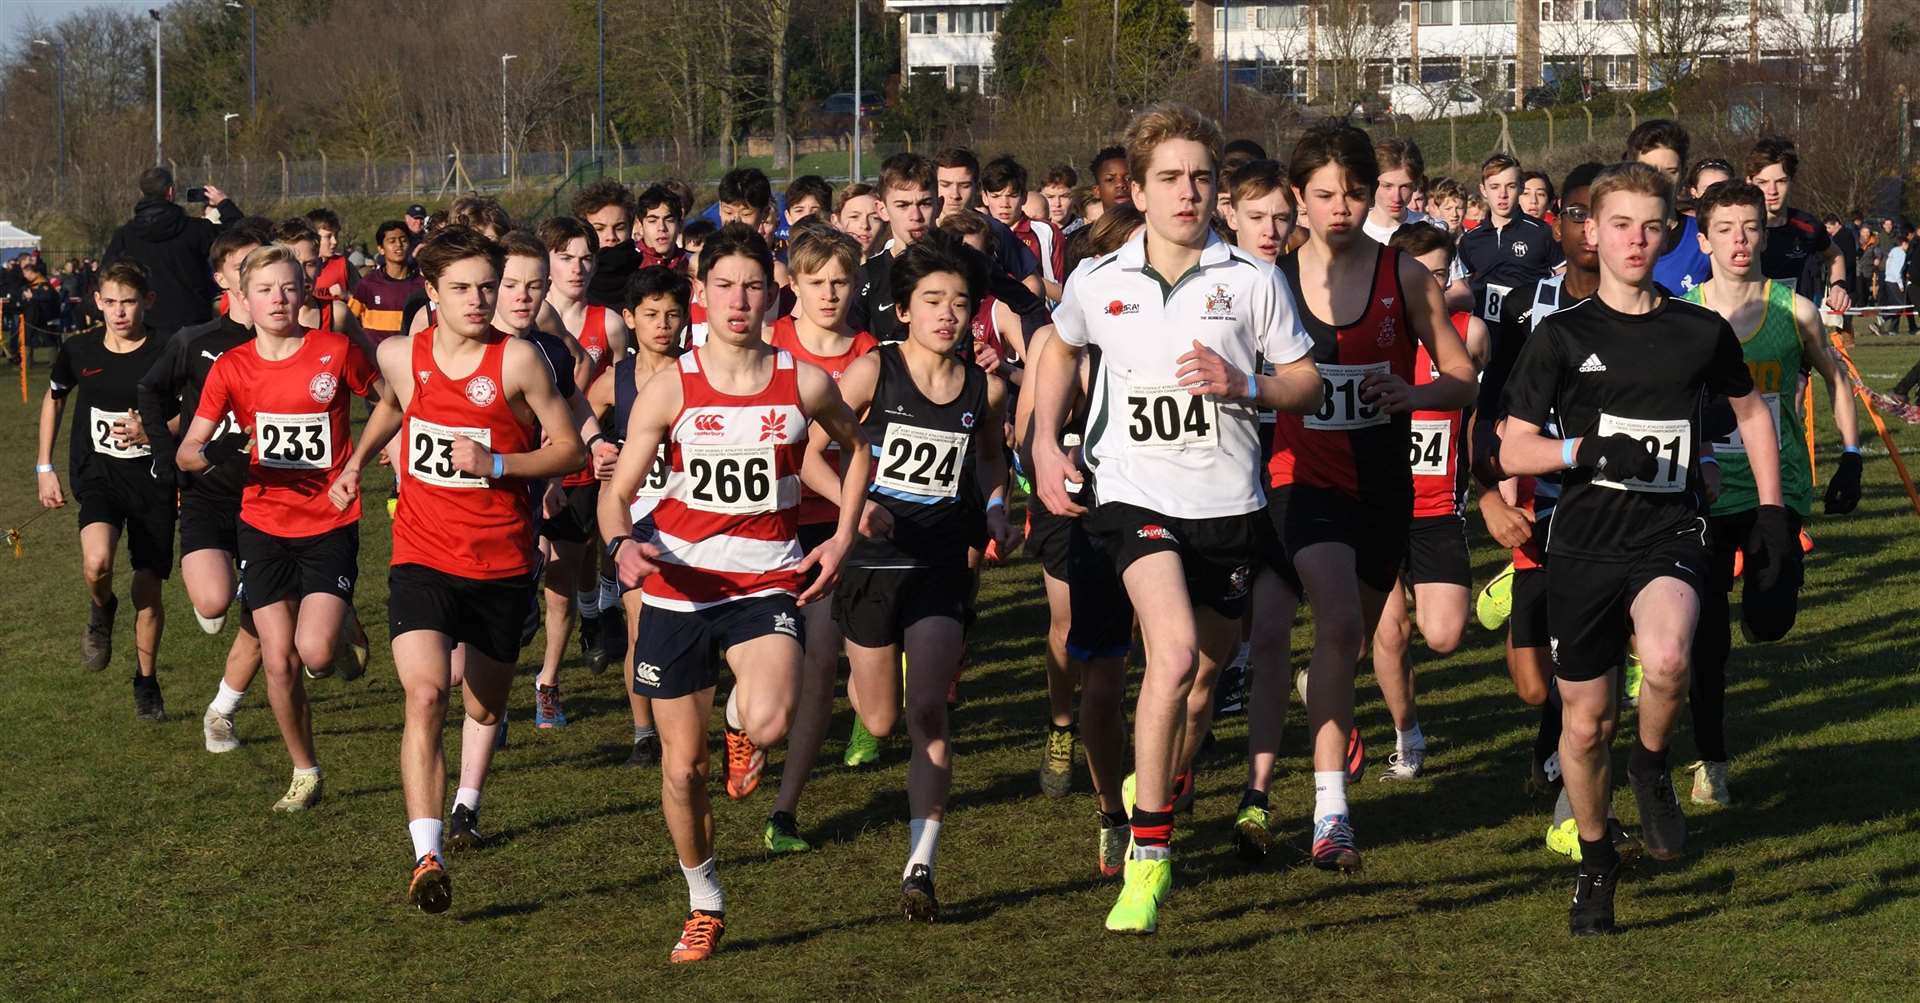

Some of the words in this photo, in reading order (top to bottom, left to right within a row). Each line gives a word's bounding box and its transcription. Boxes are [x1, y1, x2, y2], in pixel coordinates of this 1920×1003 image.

[1579, 365, 1607, 373] adidas
[1127, 395, 1211, 442] 304
[263, 424, 326, 462] 233
[414, 432, 482, 479] 23
[883, 438, 959, 487] 224
[690, 457, 770, 504] 266
